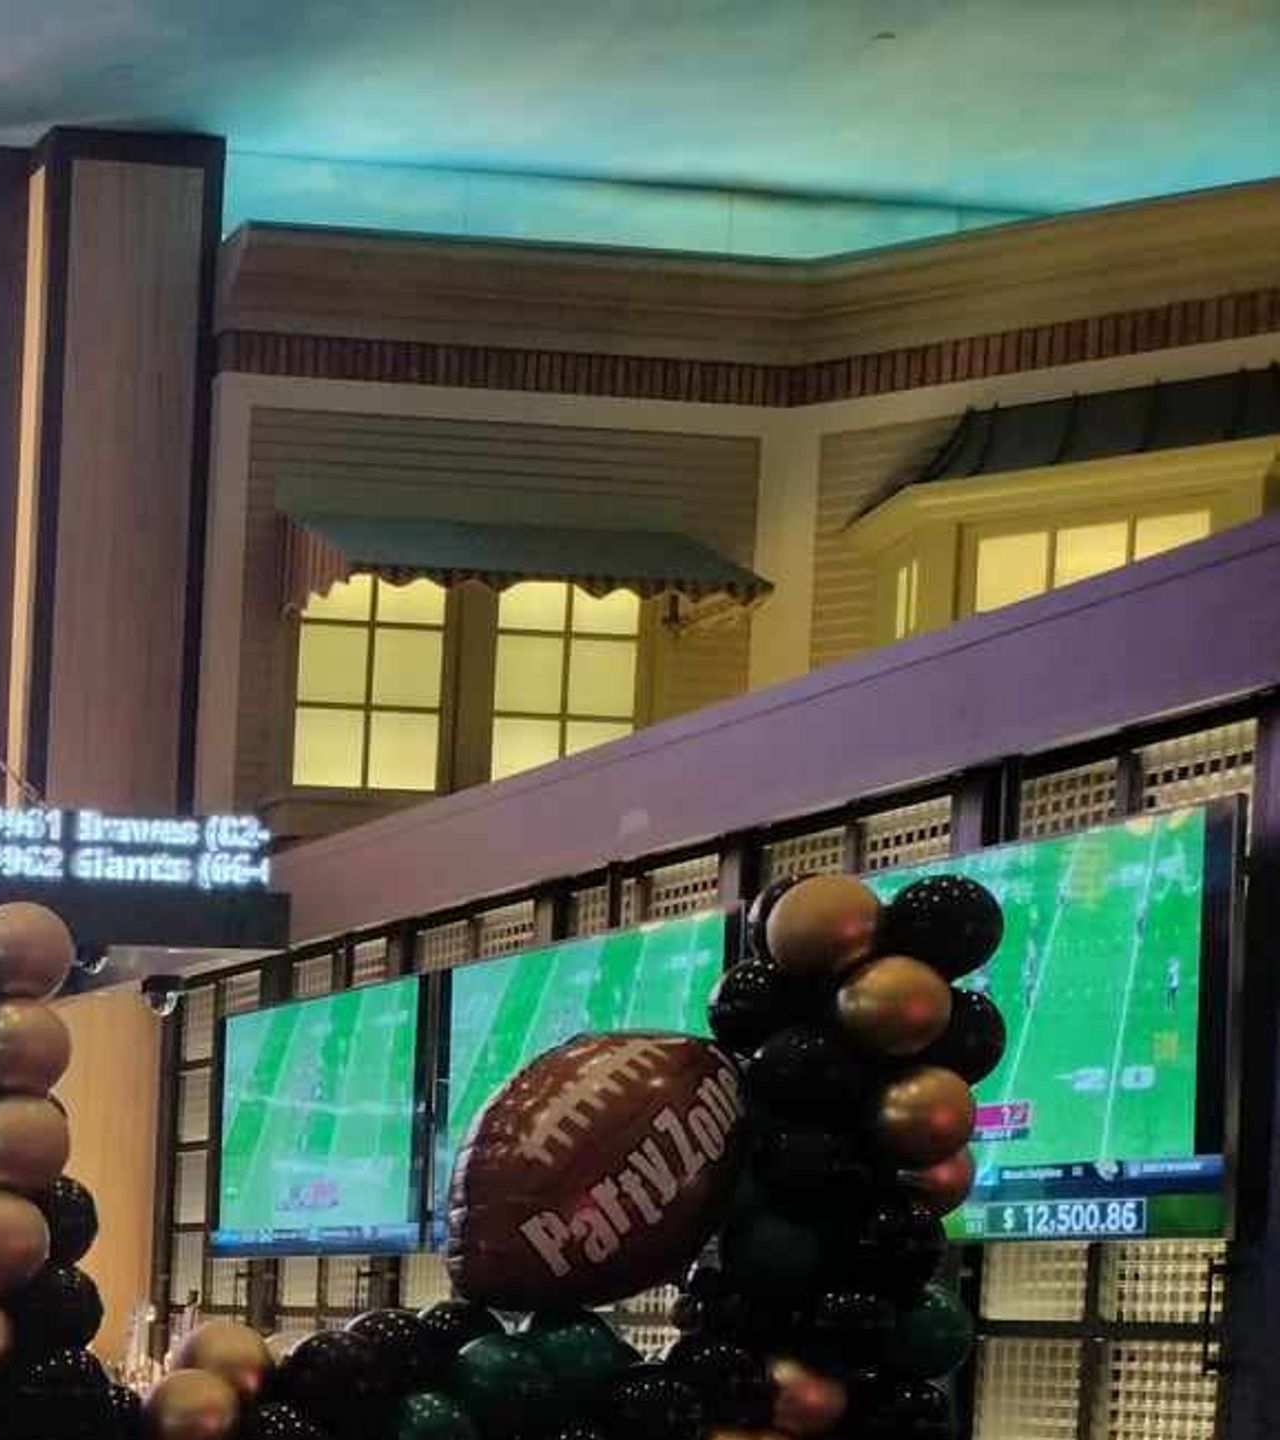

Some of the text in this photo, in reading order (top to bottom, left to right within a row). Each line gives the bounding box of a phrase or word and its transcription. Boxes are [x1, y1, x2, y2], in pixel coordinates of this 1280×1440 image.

[76, 809, 199, 845] Braves
[70, 848, 191, 882] Giants
[520, 1138, 678, 1277] Party
[1024, 1202, 1138, 1234] 12,500.86
